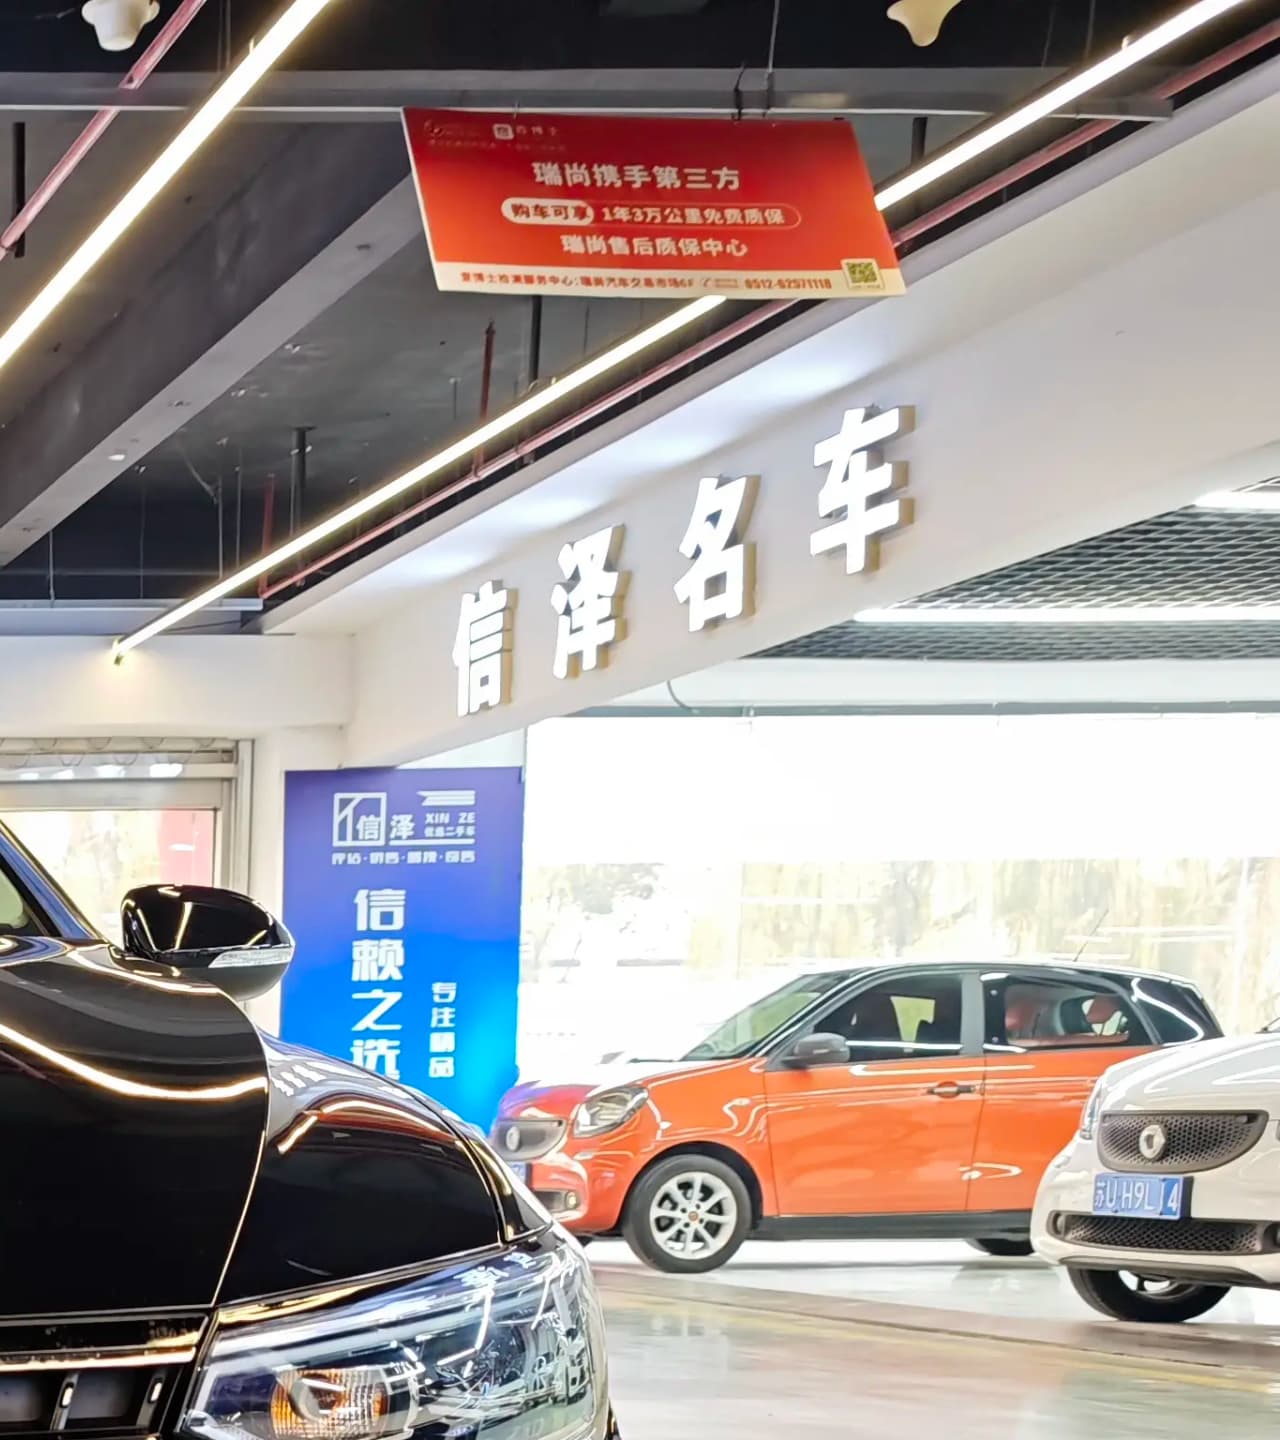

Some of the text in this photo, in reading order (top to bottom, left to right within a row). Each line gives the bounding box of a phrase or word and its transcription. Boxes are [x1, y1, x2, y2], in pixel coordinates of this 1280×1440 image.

[532, 161, 741, 191] 瑞尚携手第三方
[601, 205, 785, 226] 1年3万公里免费质保
[561, 235, 748, 258] 瑞尚售后质保中心
[452, 402, 912, 717] 信泽名车
[356, 814, 415, 841] 信泽
[425, 812, 476, 825] XIN ZE
[349, 888, 406, 1081] 信赖之选
